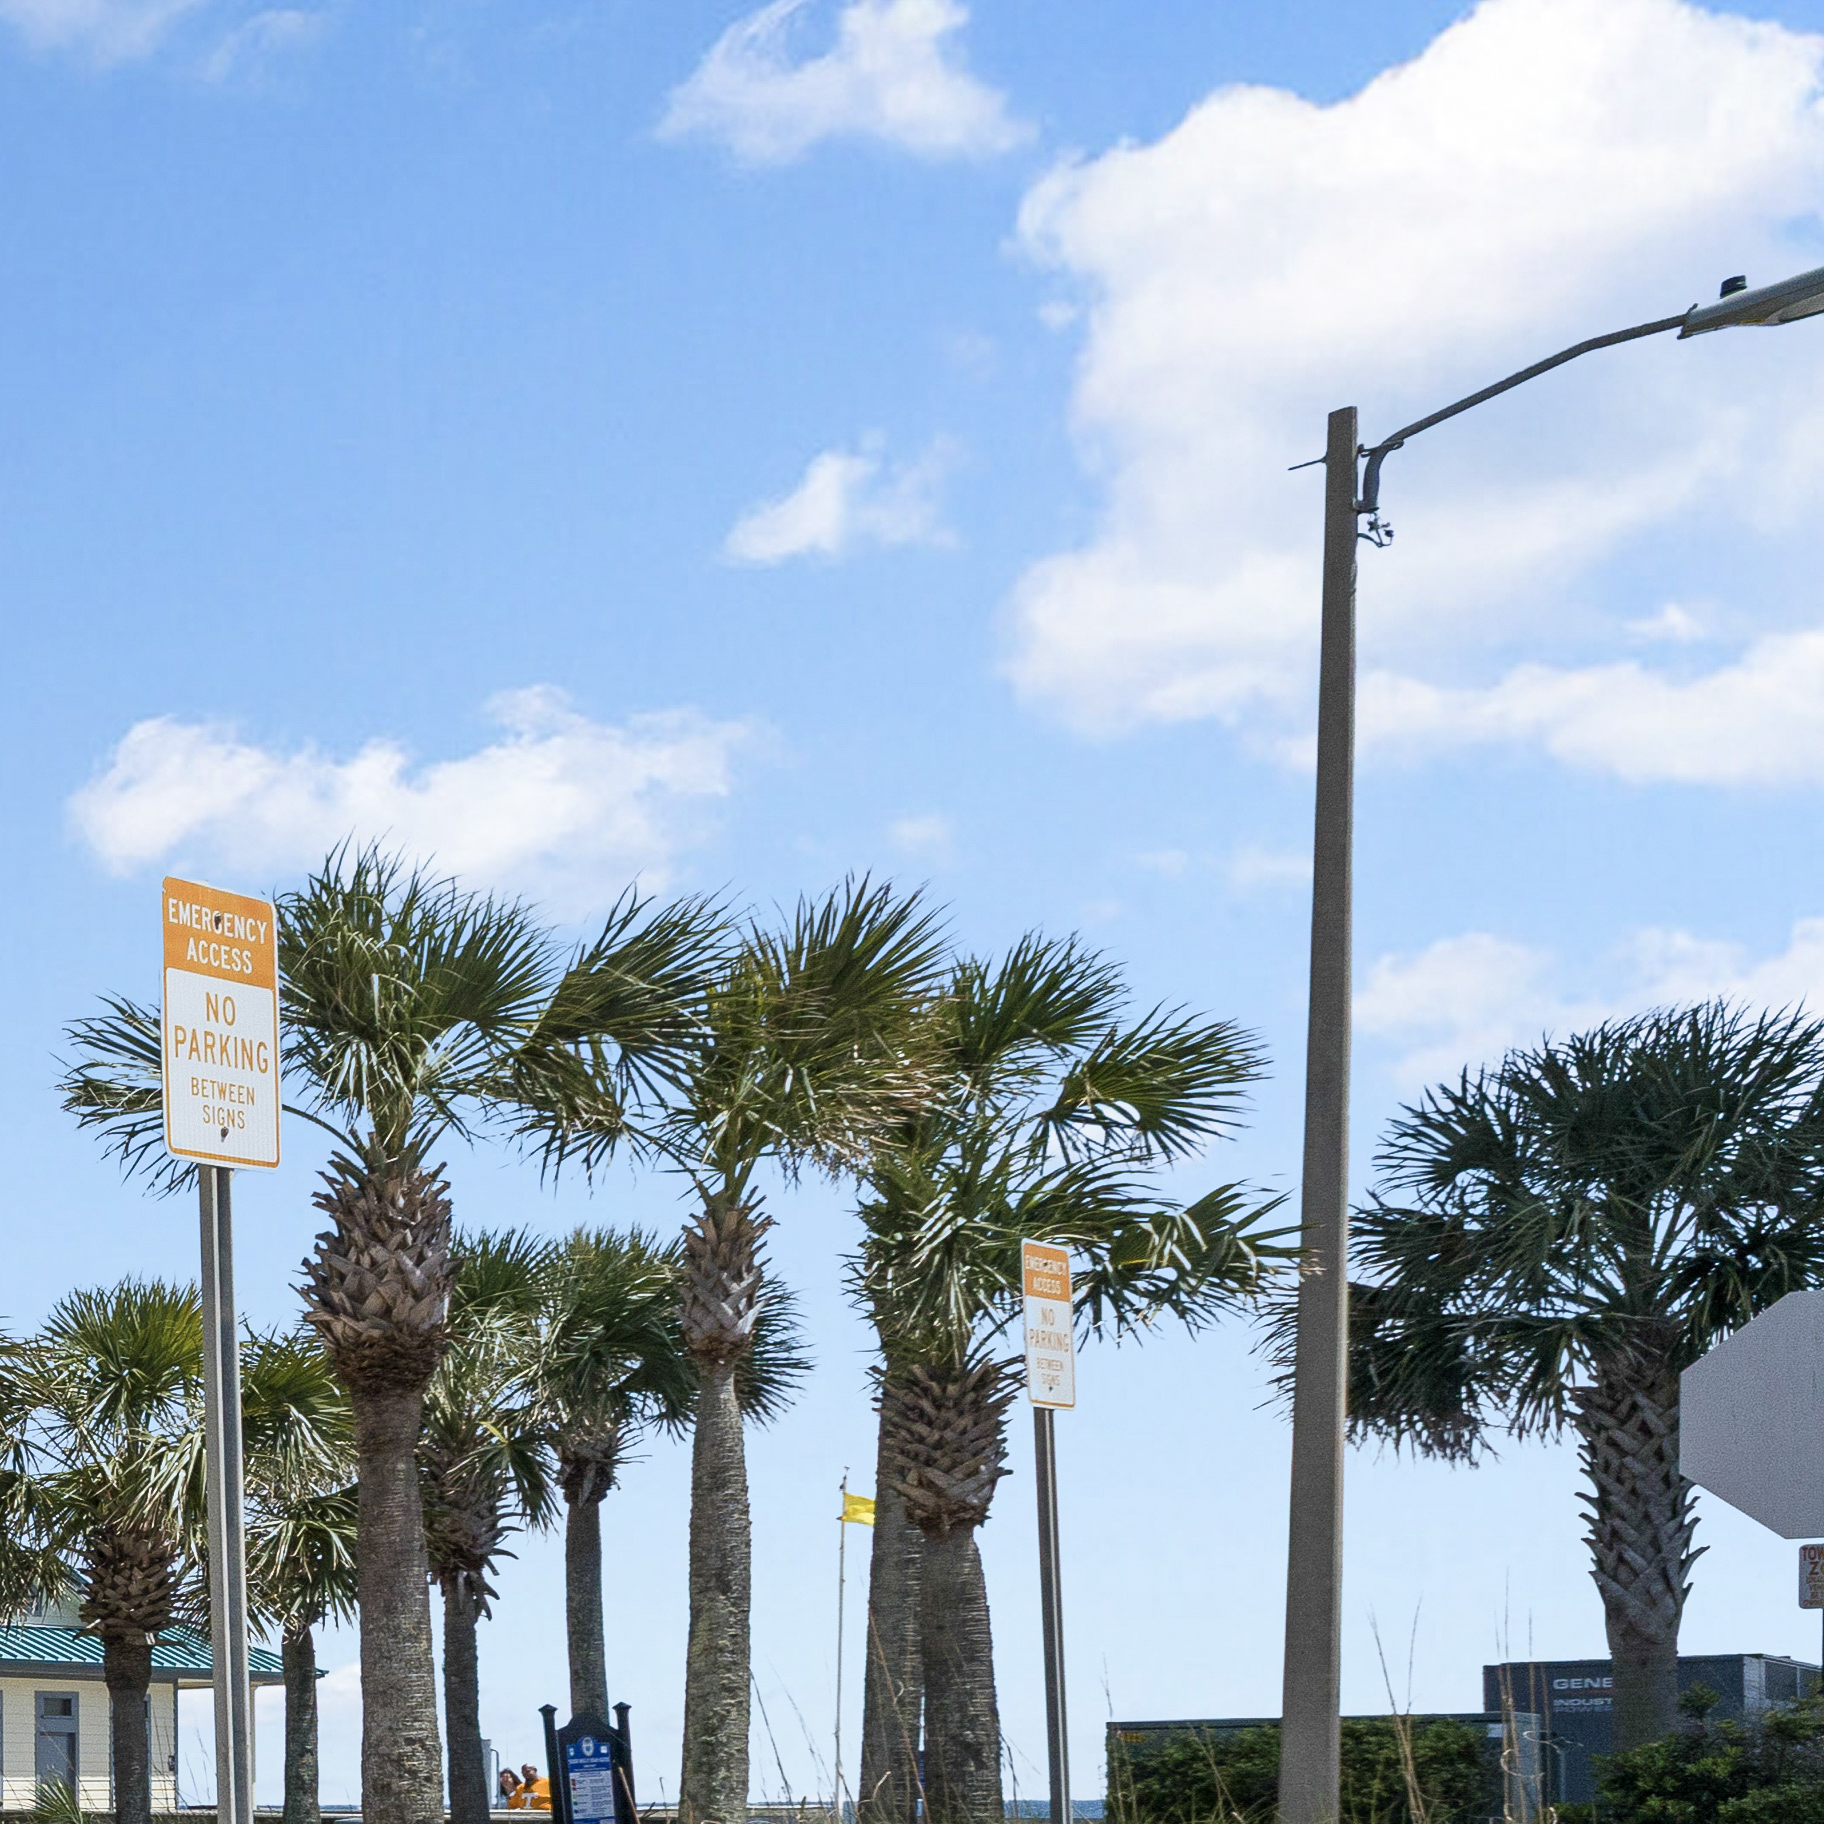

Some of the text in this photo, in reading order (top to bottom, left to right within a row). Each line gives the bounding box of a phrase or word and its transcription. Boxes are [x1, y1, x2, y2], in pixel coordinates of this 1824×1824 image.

[167, 897, 268, 945] EMERGENCY
[186, 937, 253, 974] ACCESS
[205, 991, 236, 1026] NO
[174, 1025, 269, 1074] PARKING
[191, 1076, 255, 1106] BETWEEN
[203, 1104, 245, 1130] SIGNS
[1041, 1307, 1055, 1326] NO
[1029, 1328, 1069, 1353] PARKING
[521, 1792, 539, 1808] T
